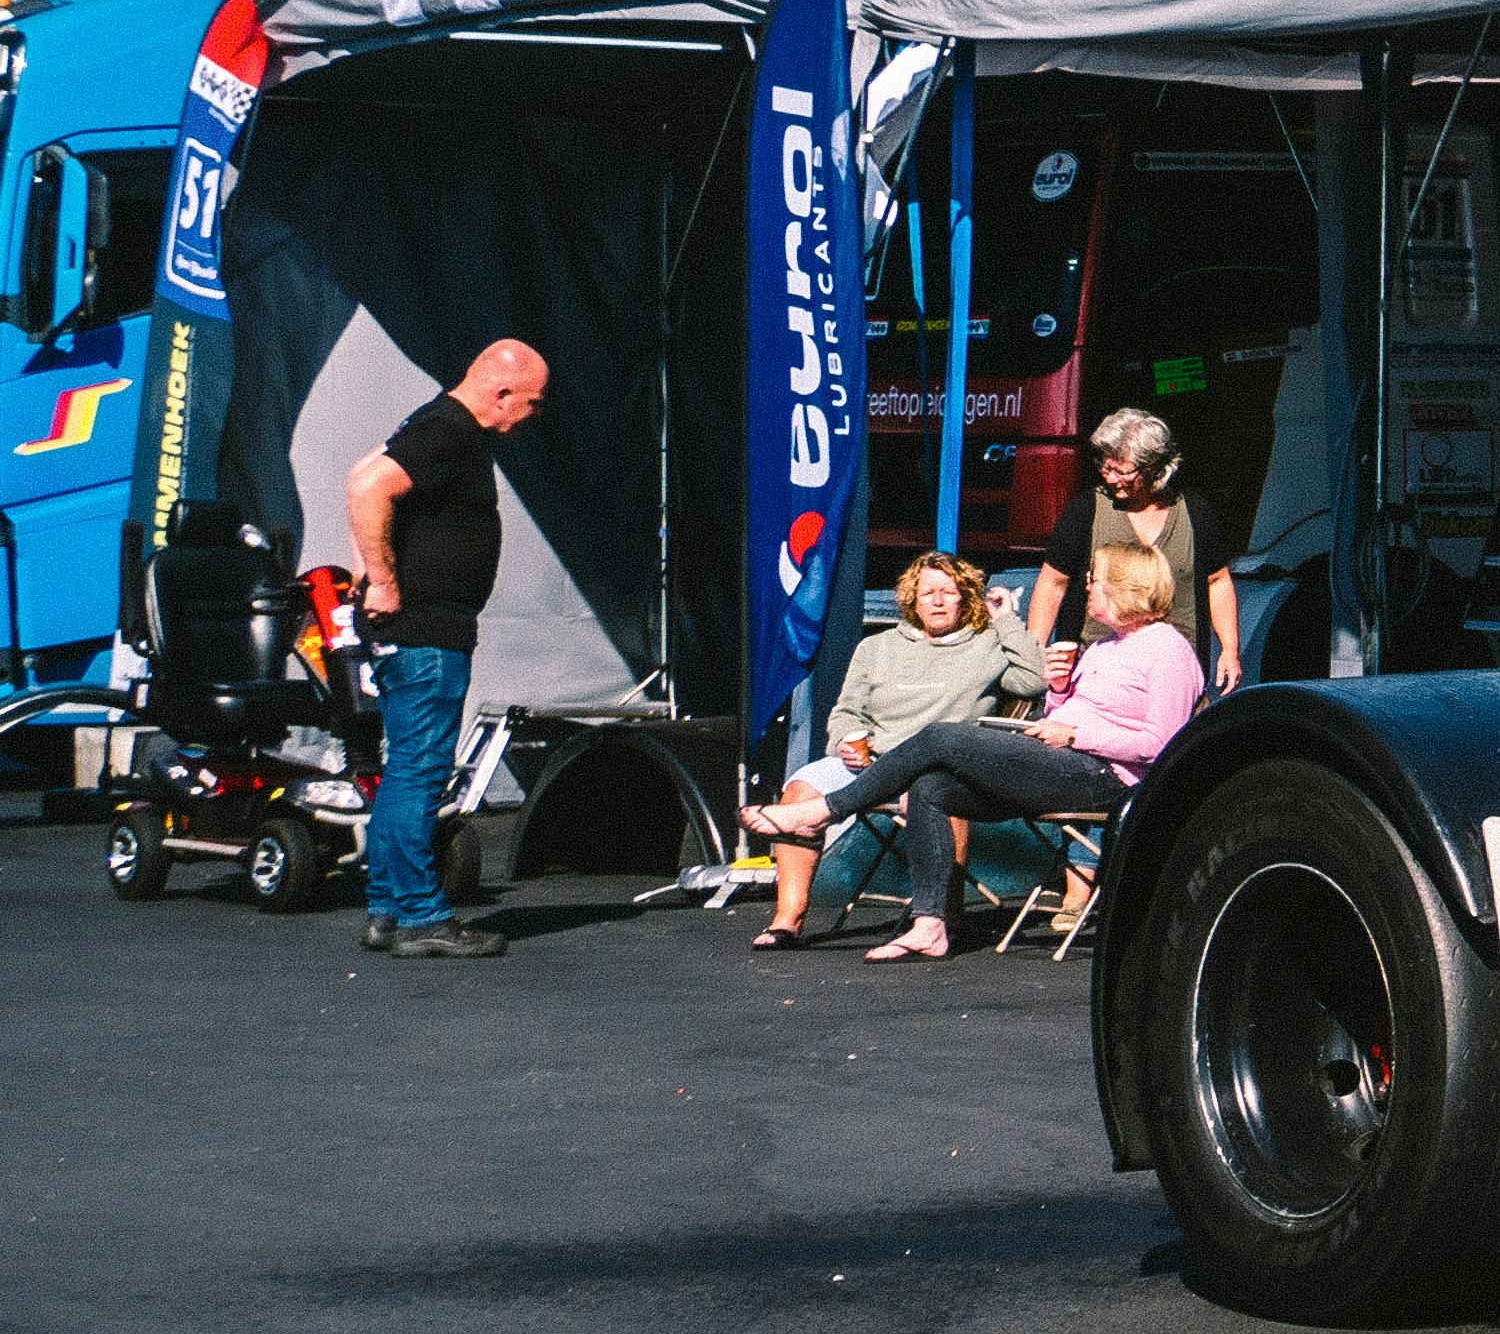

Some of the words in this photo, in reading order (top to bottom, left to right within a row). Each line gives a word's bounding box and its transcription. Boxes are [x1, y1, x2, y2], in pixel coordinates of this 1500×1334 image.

[178, 155, 221, 240] 51
[771, 85, 832, 488] eurol
[812, 145, 850, 436] LUBRICANTS
